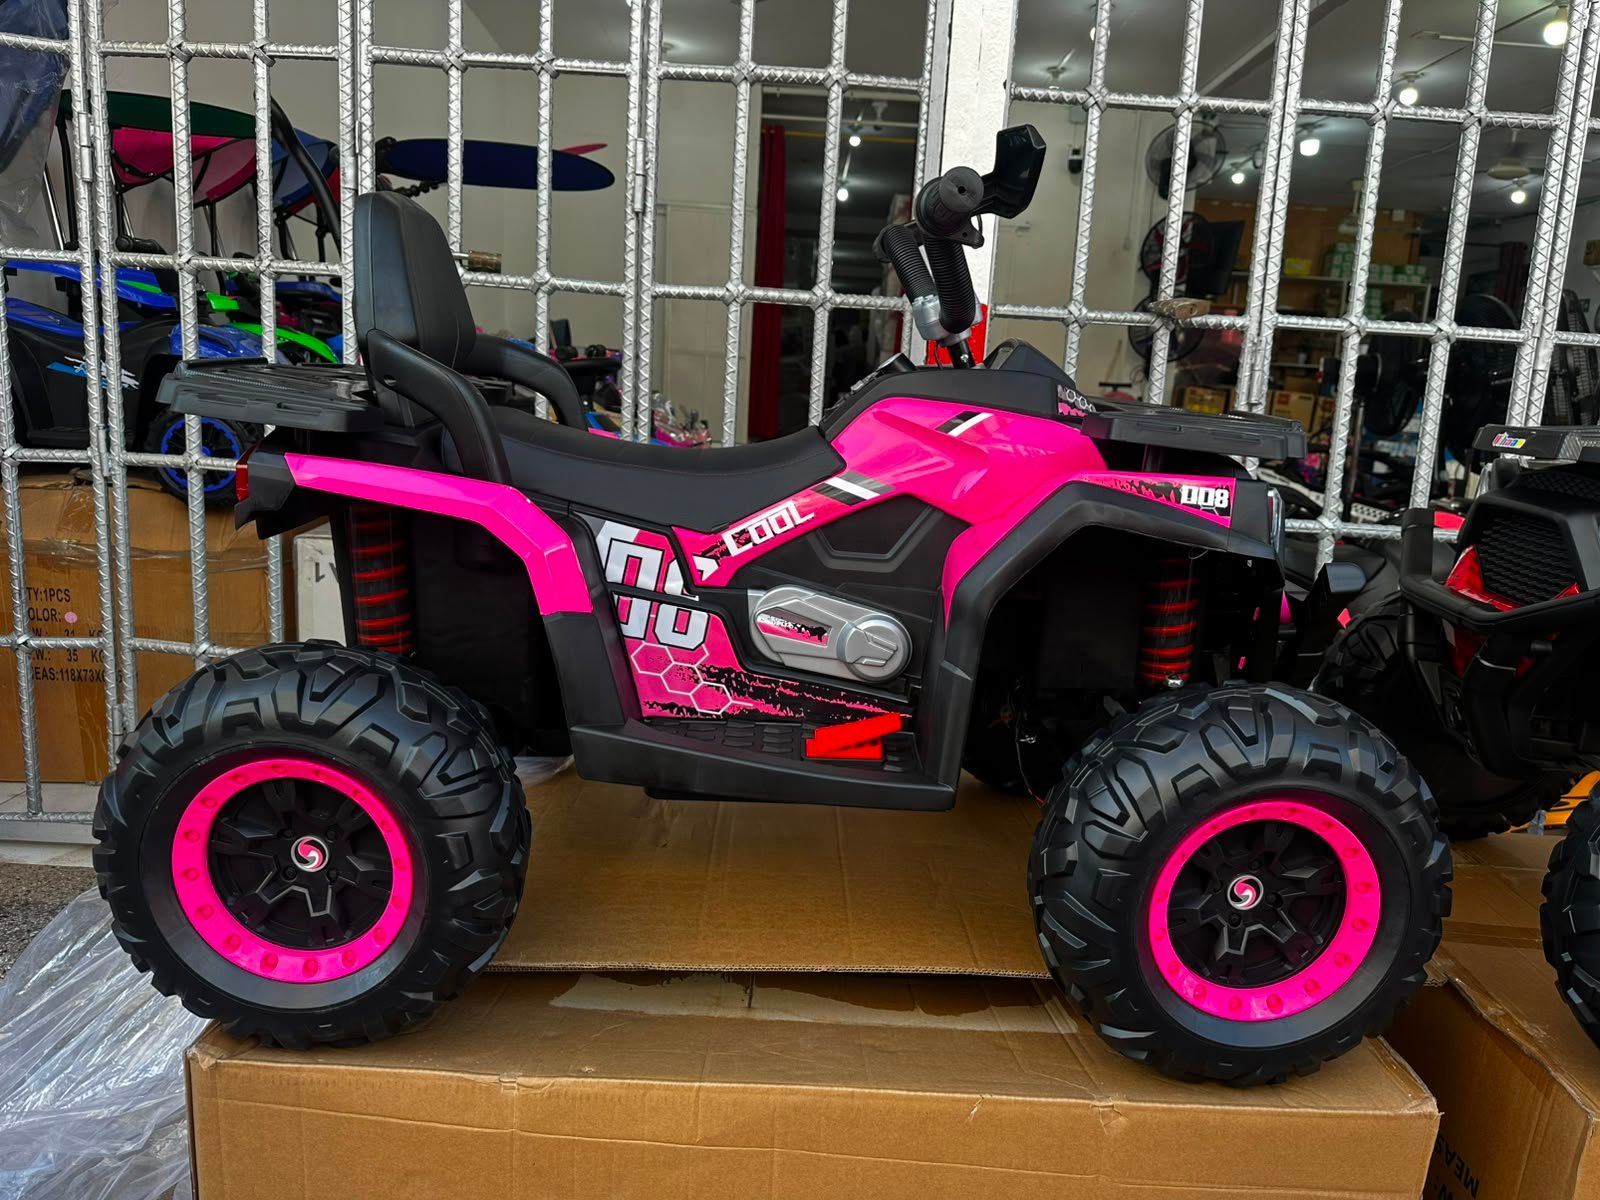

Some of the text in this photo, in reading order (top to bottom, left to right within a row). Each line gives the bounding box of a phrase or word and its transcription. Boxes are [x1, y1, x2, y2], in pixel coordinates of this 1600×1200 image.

[1180, 485, 1229, 508] 008
[722, 500, 815, 557] COOL
[27, 587, 71, 603] TY:1PCS
[28, 607, 62, 622] OLOR:
[66, 649, 79, 662] 35
